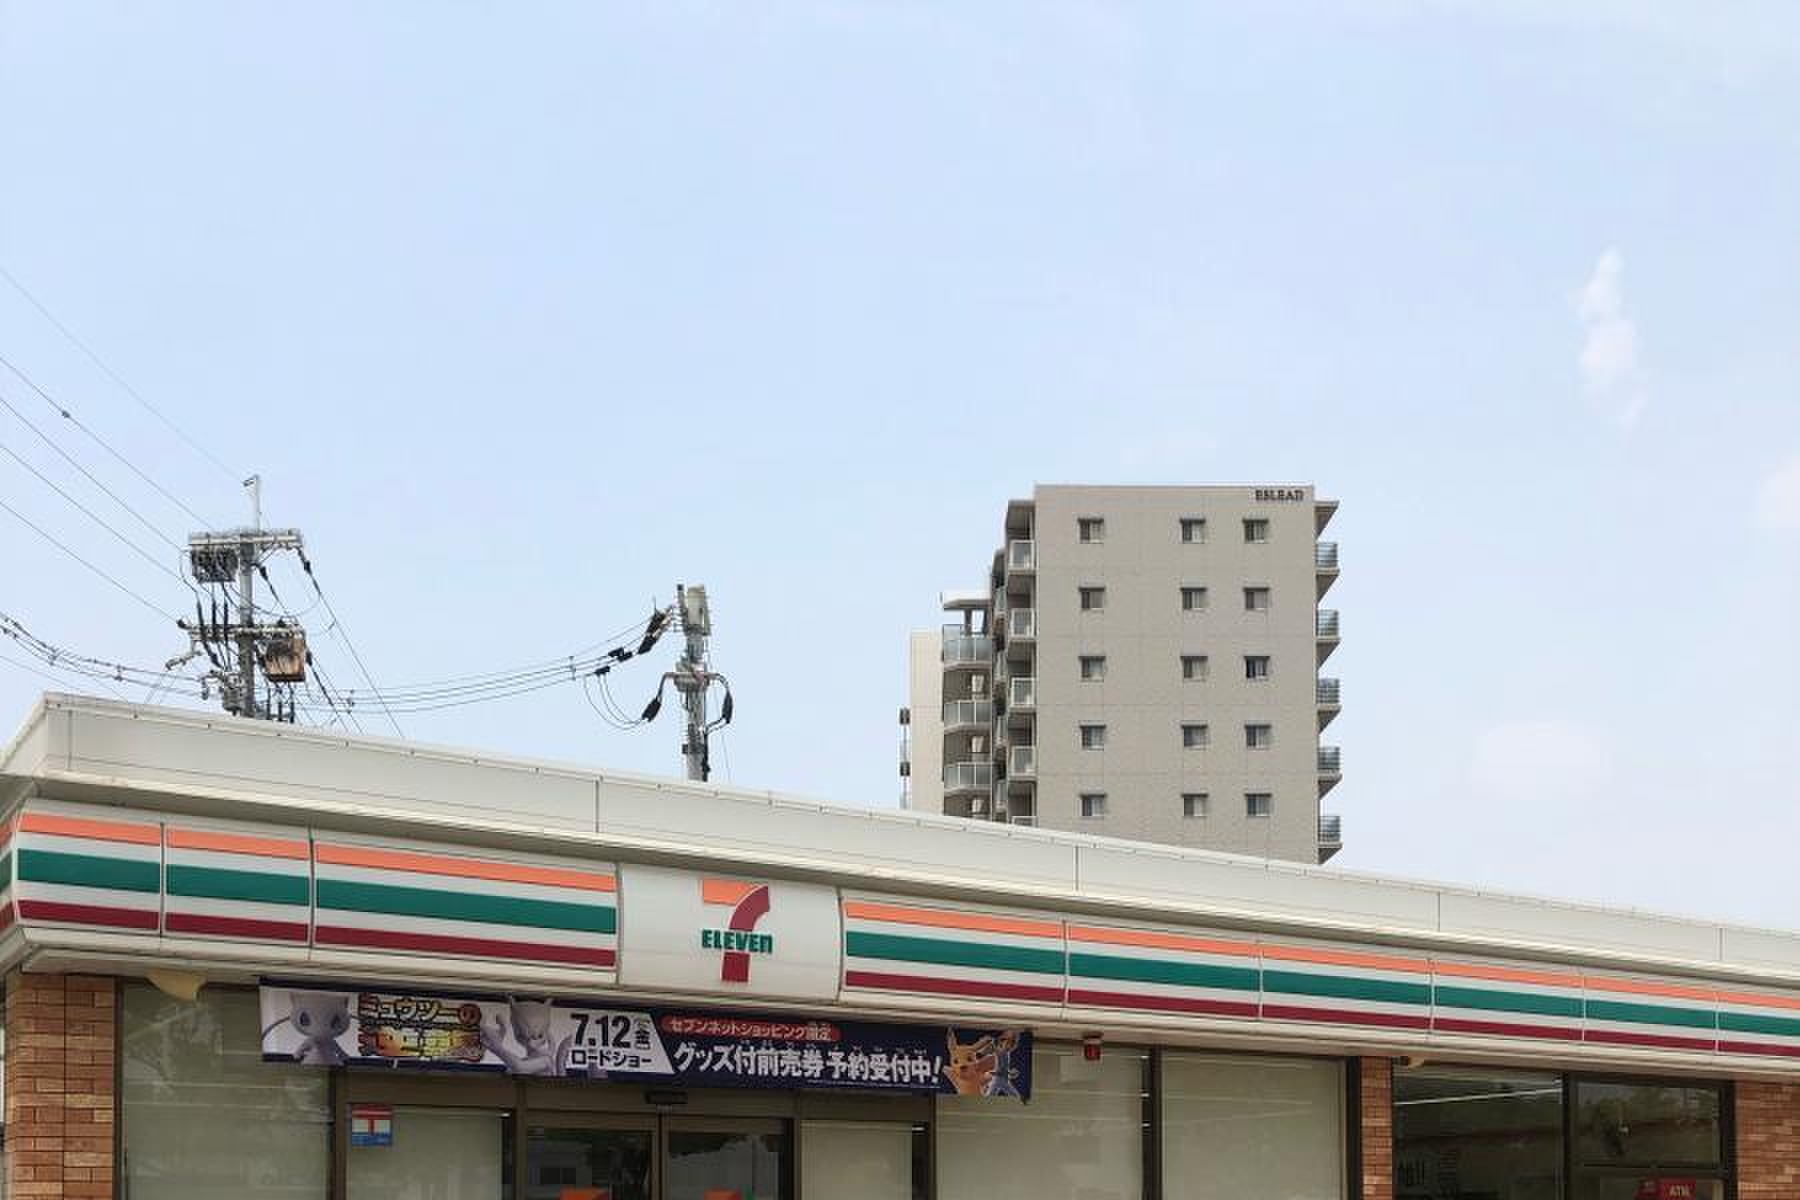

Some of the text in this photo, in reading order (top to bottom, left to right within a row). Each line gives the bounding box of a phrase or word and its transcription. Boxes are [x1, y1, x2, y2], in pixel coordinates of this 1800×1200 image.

[571, 1049, 652, 1069] ロードショー
